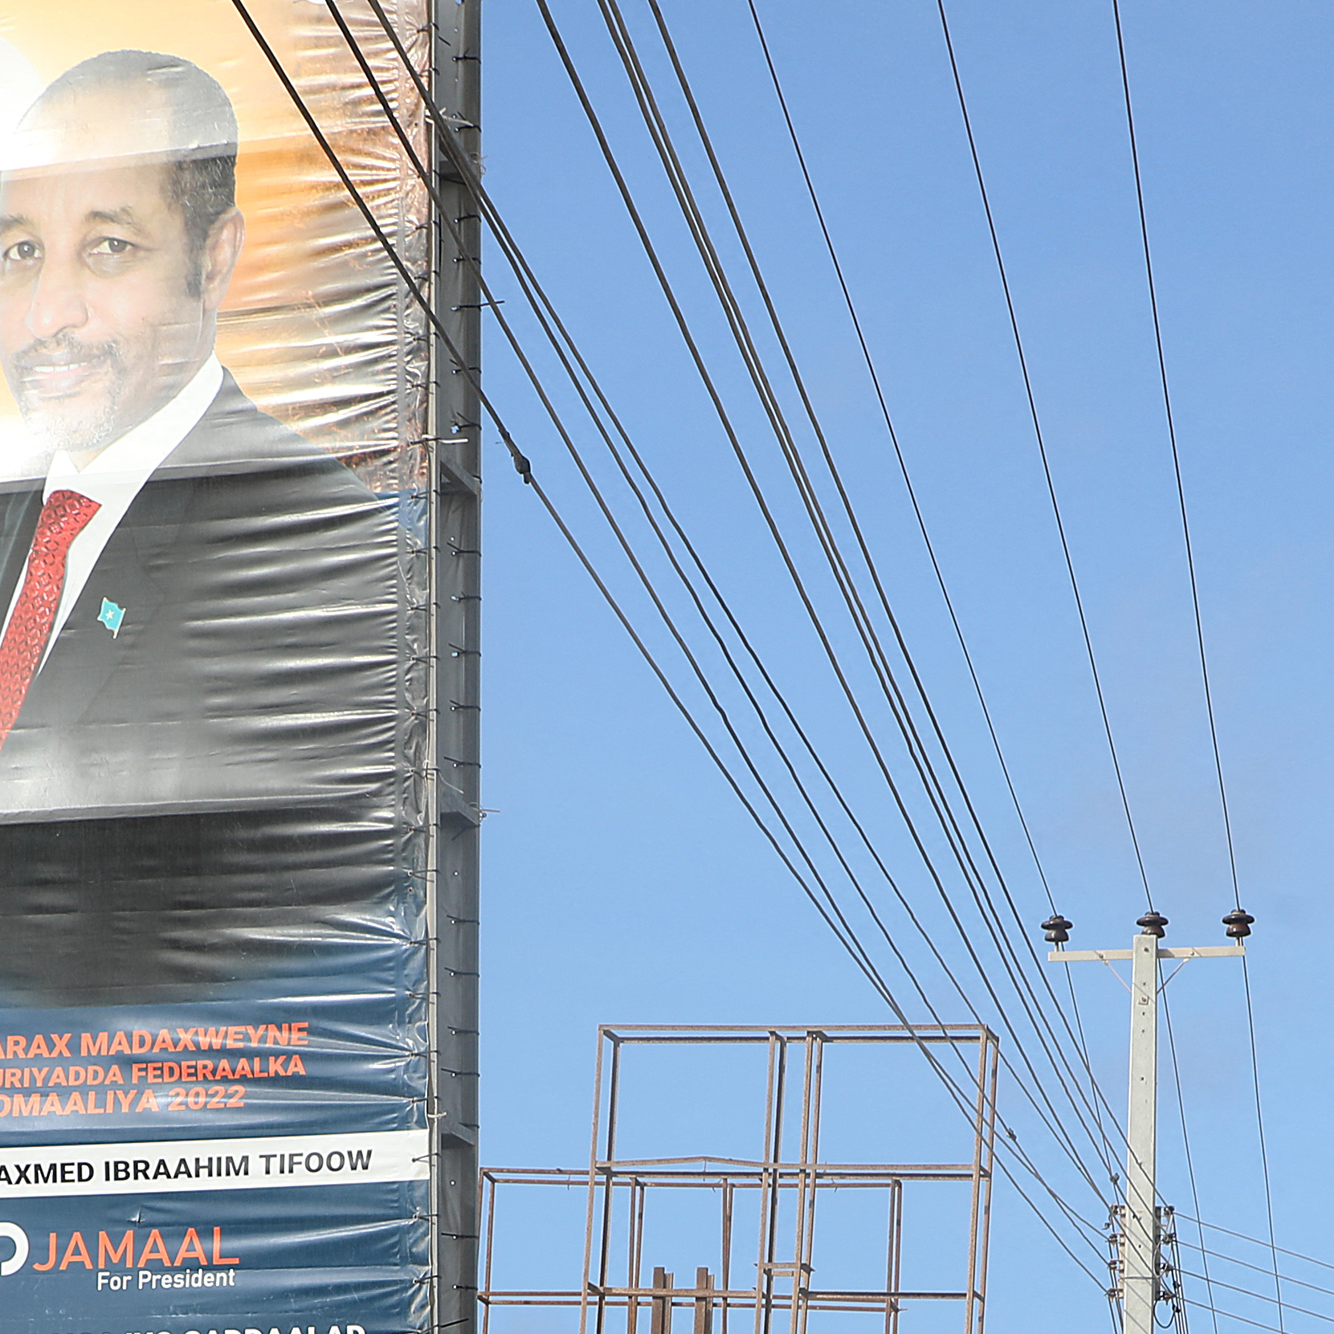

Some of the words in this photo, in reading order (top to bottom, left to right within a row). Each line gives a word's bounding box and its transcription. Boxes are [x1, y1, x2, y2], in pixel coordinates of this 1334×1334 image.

[80, 1022, 309, 1056] MADAXWEYNE
[132, 1054, 306, 1084] FEDERAALKA
[168, 1084, 246, 1112] 2022
[103, 1155, 250, 1182] IBRAAHIM
[258, 1149, 373, 1176] TIFOOW
[32, 1226, 240, 1272] JAMAAL
[97, 1271, 132, 1291] For
[138, 1268, 236, 1290] President
